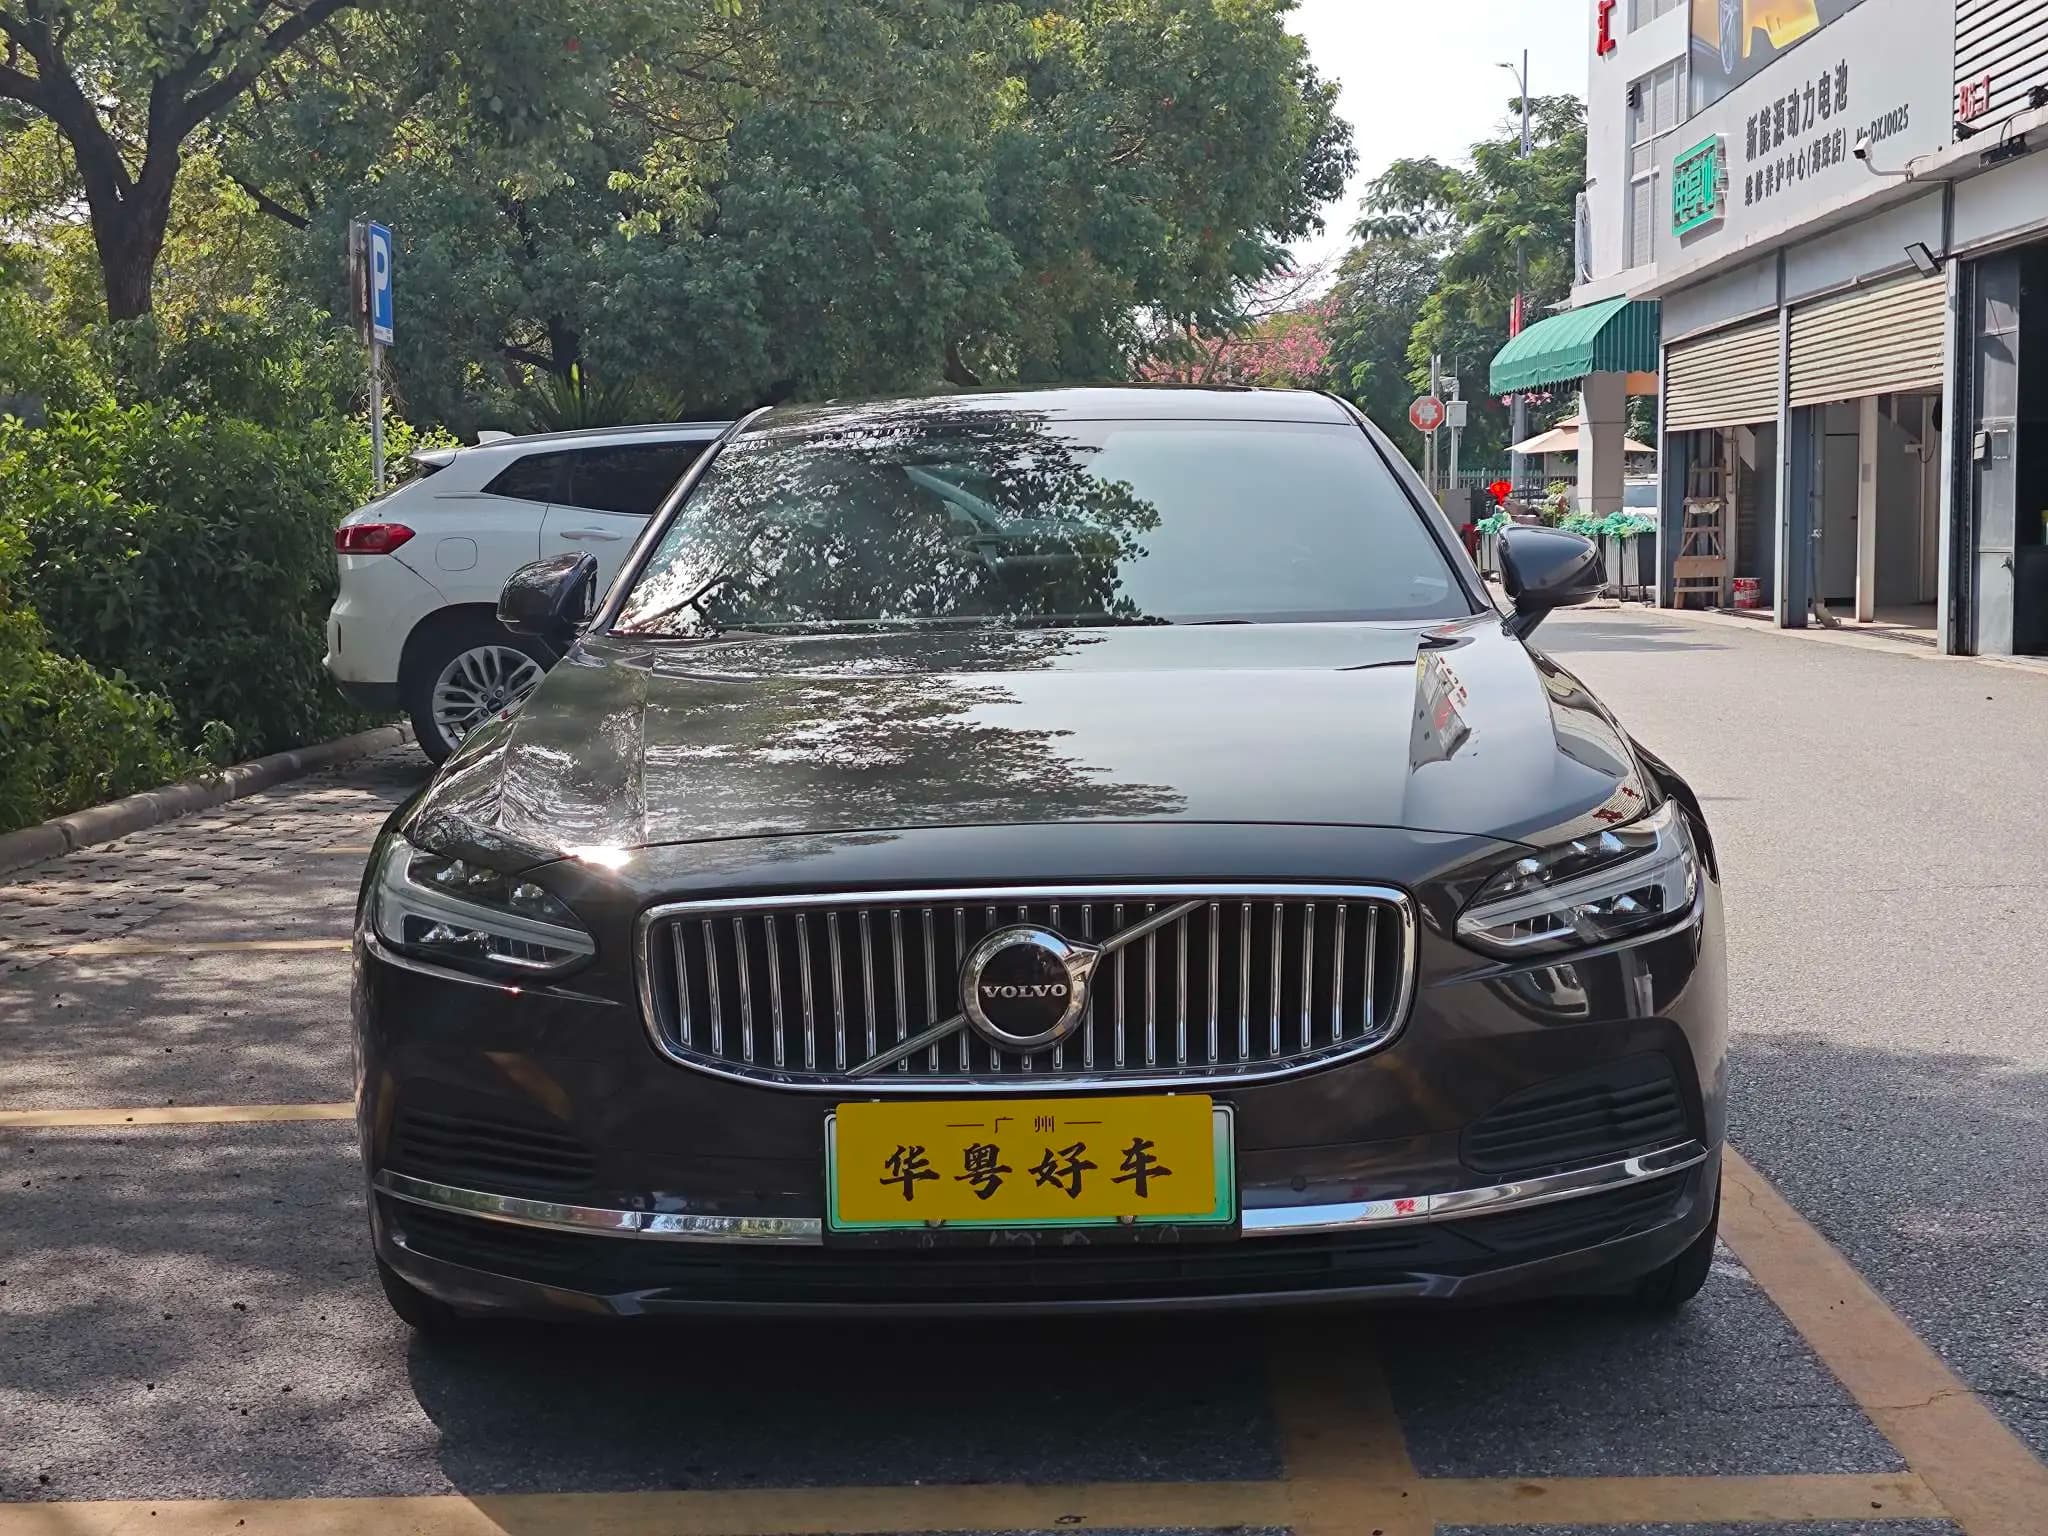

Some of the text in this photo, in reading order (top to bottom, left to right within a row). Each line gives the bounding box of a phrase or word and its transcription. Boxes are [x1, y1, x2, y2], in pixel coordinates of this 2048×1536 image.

[1746, 58, 1848, 162] 新能源动力电池
[373, 234, 389, 318] P
[982, 983, 1067, 998] VOLVO
[994, 1116, 1055, 1133] 广州
[879, 1137, 1172, 1202] 华粤好车
